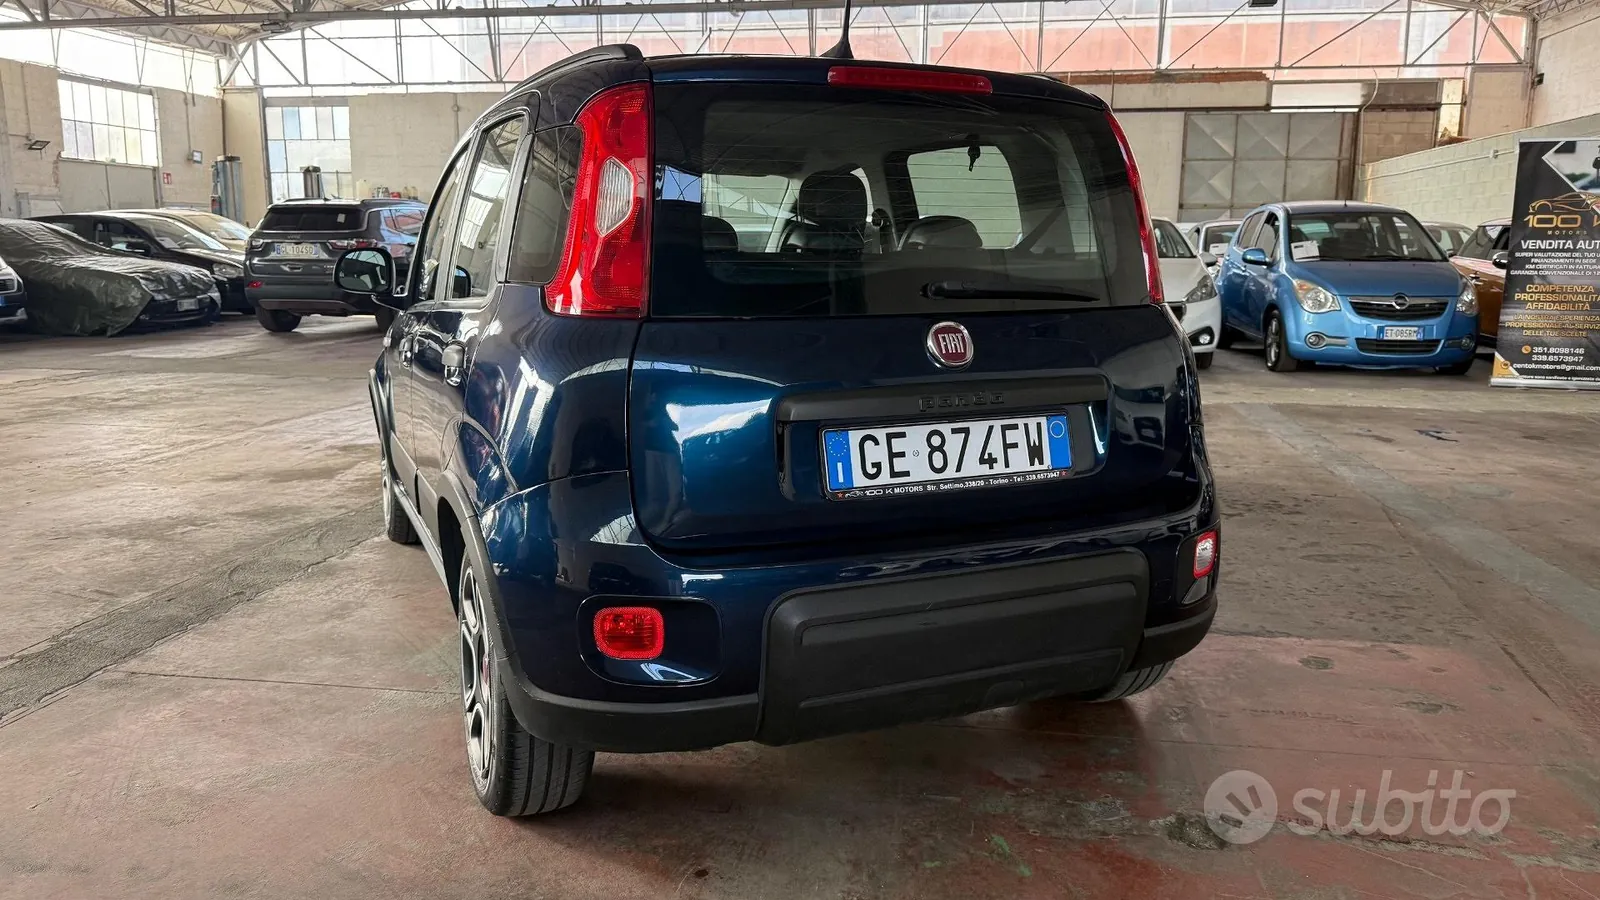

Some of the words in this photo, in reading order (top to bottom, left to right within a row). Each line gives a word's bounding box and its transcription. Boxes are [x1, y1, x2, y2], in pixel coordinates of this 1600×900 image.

[1523, 214, 1582, 228] 100
[1521, 240, 1574, 249] VENDITA
[1526, 284, 1594, 293] COMPETENZA
[1526, 302, 1590, 310] AFFIDABILITÀ
[938, 333, 965, 354] FIAT
[836, 462, 844, 483] I
[858, 431, 911, 481] GE
[926, 421, 1045, 475] 874FW
[894, 485, 924, 494] MOTORS
[1013, 475, 1025, 483] Tel:
[1025, 471, 1060, 481] 339.6573947
